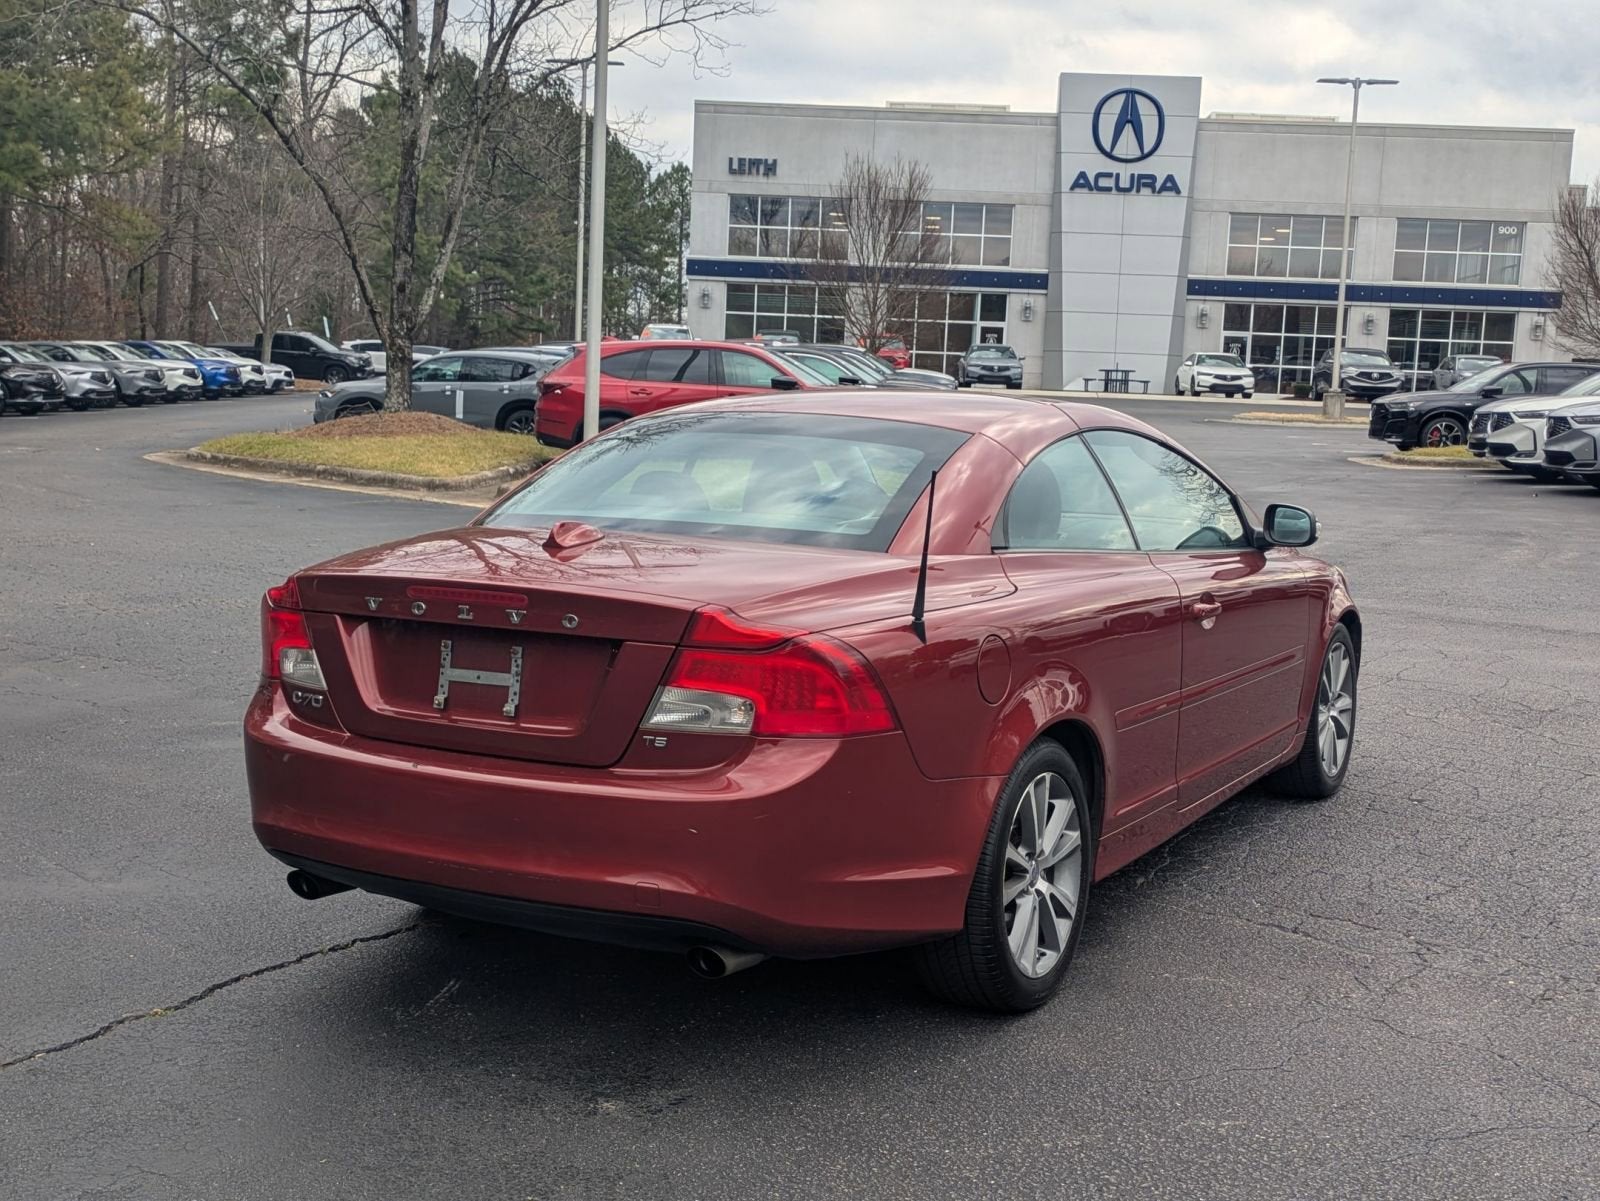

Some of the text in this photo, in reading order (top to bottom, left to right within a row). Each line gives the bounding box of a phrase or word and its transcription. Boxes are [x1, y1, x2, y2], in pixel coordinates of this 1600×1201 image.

[728, 156, 777, 176] LEITH
[1069, 170, 1182, 194] ACURA
[1498, 225, 1518, 235] 900
[365, 596, 579, 628] VOLVO
[292, 690, 323, 708] C70
[642, 735, 668, 747] T5
